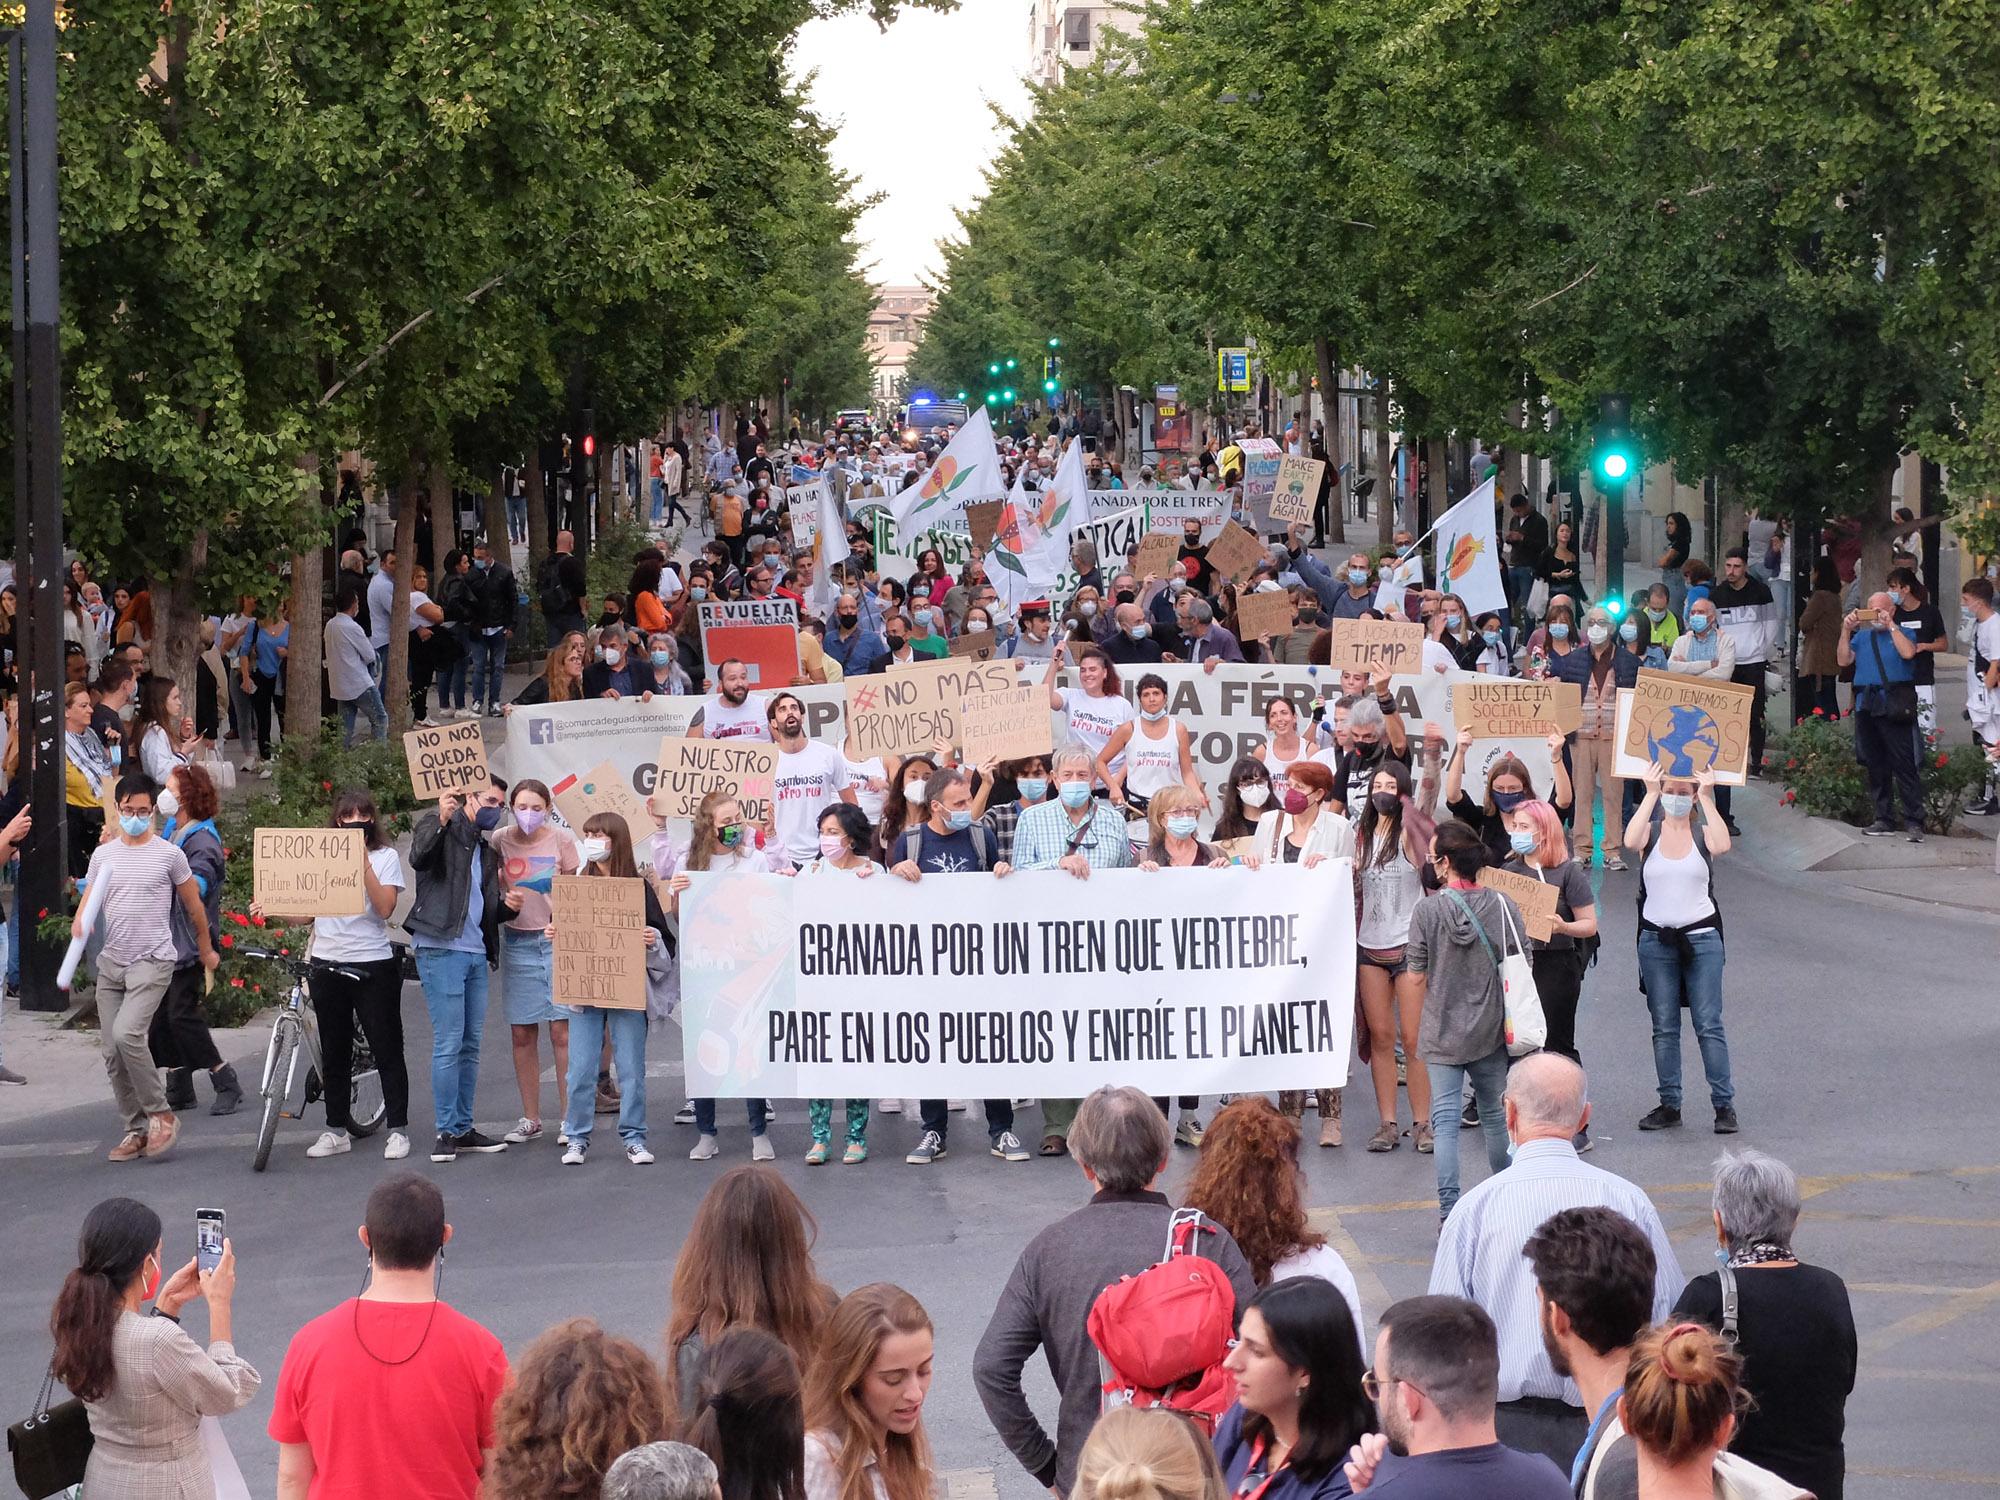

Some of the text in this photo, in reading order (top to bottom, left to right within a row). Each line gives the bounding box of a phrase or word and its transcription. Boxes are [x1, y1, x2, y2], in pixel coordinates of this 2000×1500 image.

[1282, 469, 1314, 481] EARTH
[1285, 458, 1315, 472] MAKE
[789, 493, 801, 505] NO
[1173, 496, 1187, 507] EL
[1191, 496, 1224, 507] TREN
[1277, 493, 1307, 507] COOL
[1273, 504, 1309, 521] AGAIN
[701, 602, 793, 619] REVUELTA
[1721, 607, 1757, 624] FILA
[937, 664, 1010, 700] MÁS
[1469, 685, 1552, 701] JUSTICIA
[1638, 681, 1743, 715] SOLO TENEMOS 1
[1472, 703, 1541, 718] SOCIAL Y
[417, 723, 480, 748] NO NOS
[854, 708, 953, 751] PROMESAS
[420, 746, 478, 769] QUEDA
[681, 745, 771, 773] NUESTRO
[416, 765, 486, 791] TIEMPO
[660, 770, 738, 796] FUTURO
[743, 778, 771, 797] NO
[775, 774, 823, 788] sambiosis
[778, 786, 822, 801] afro rua
[677, 796, 700, 816] SE
[261, 835, 351, 860] ERROR 404
[259, 869, 358, 901] Future NOT found
[1492, 871, 1507, 886] UN
[559, 885, 626, 902] NO QUIERO
[558, 906, 641, 928] QUE RESPIRAR
[559, 930, 626, 950] HONDO SEA
[799, 913, 1308, 976] GRANADA POR UN TREN QUE VERTEBRE,
[559, 955, 628, 975] UN DEPORTE
[560, 975, 572, 996] DE
[768, 998, 1334, 1064] PARE EN LOS PUEBLOS Y ENFRÍE EL PLANETA
